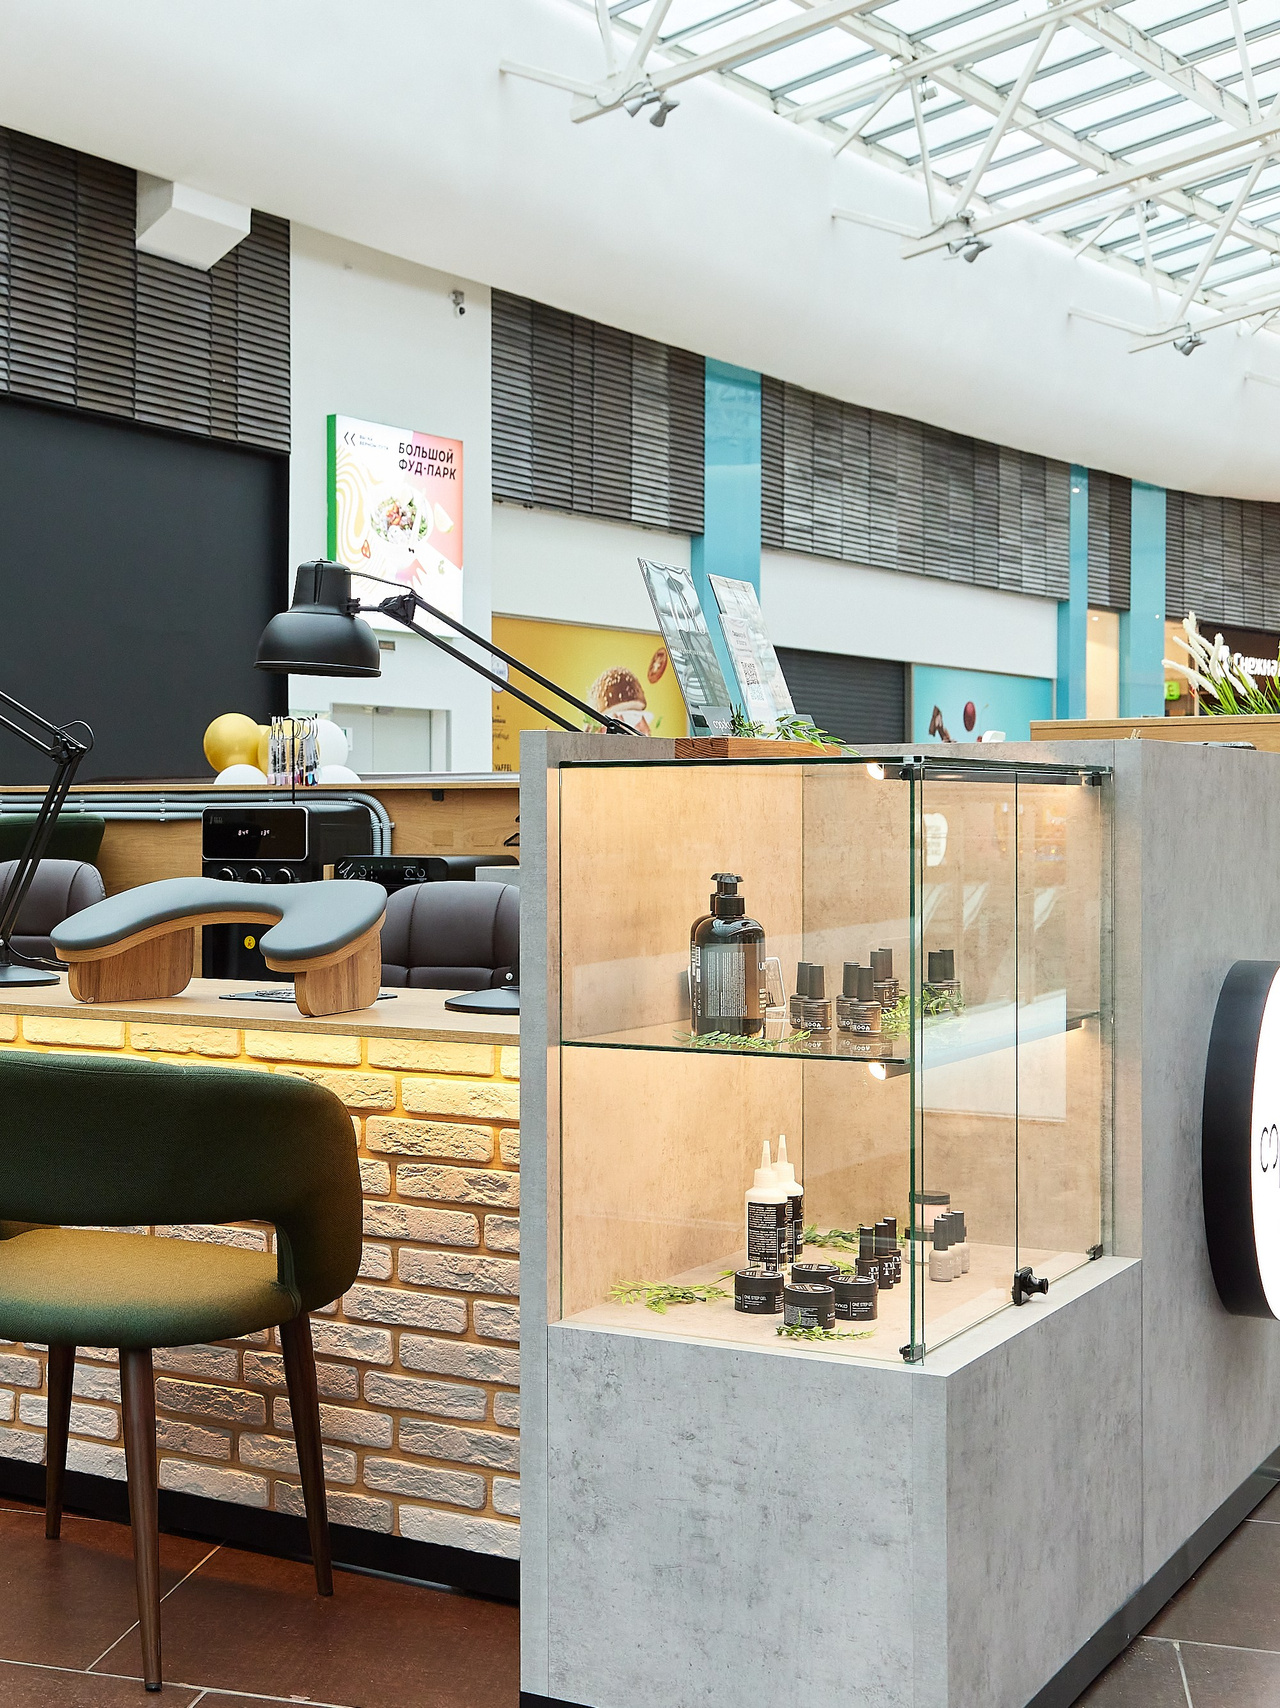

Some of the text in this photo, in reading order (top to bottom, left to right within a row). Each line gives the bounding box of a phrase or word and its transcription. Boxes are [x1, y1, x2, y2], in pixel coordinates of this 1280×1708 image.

[398, 442, 454, 464] БОЛЬШОЙ
[398, 459, 457, 480] ФУД-ПАРК
[1233, 652, 1280, 677] Снежна
